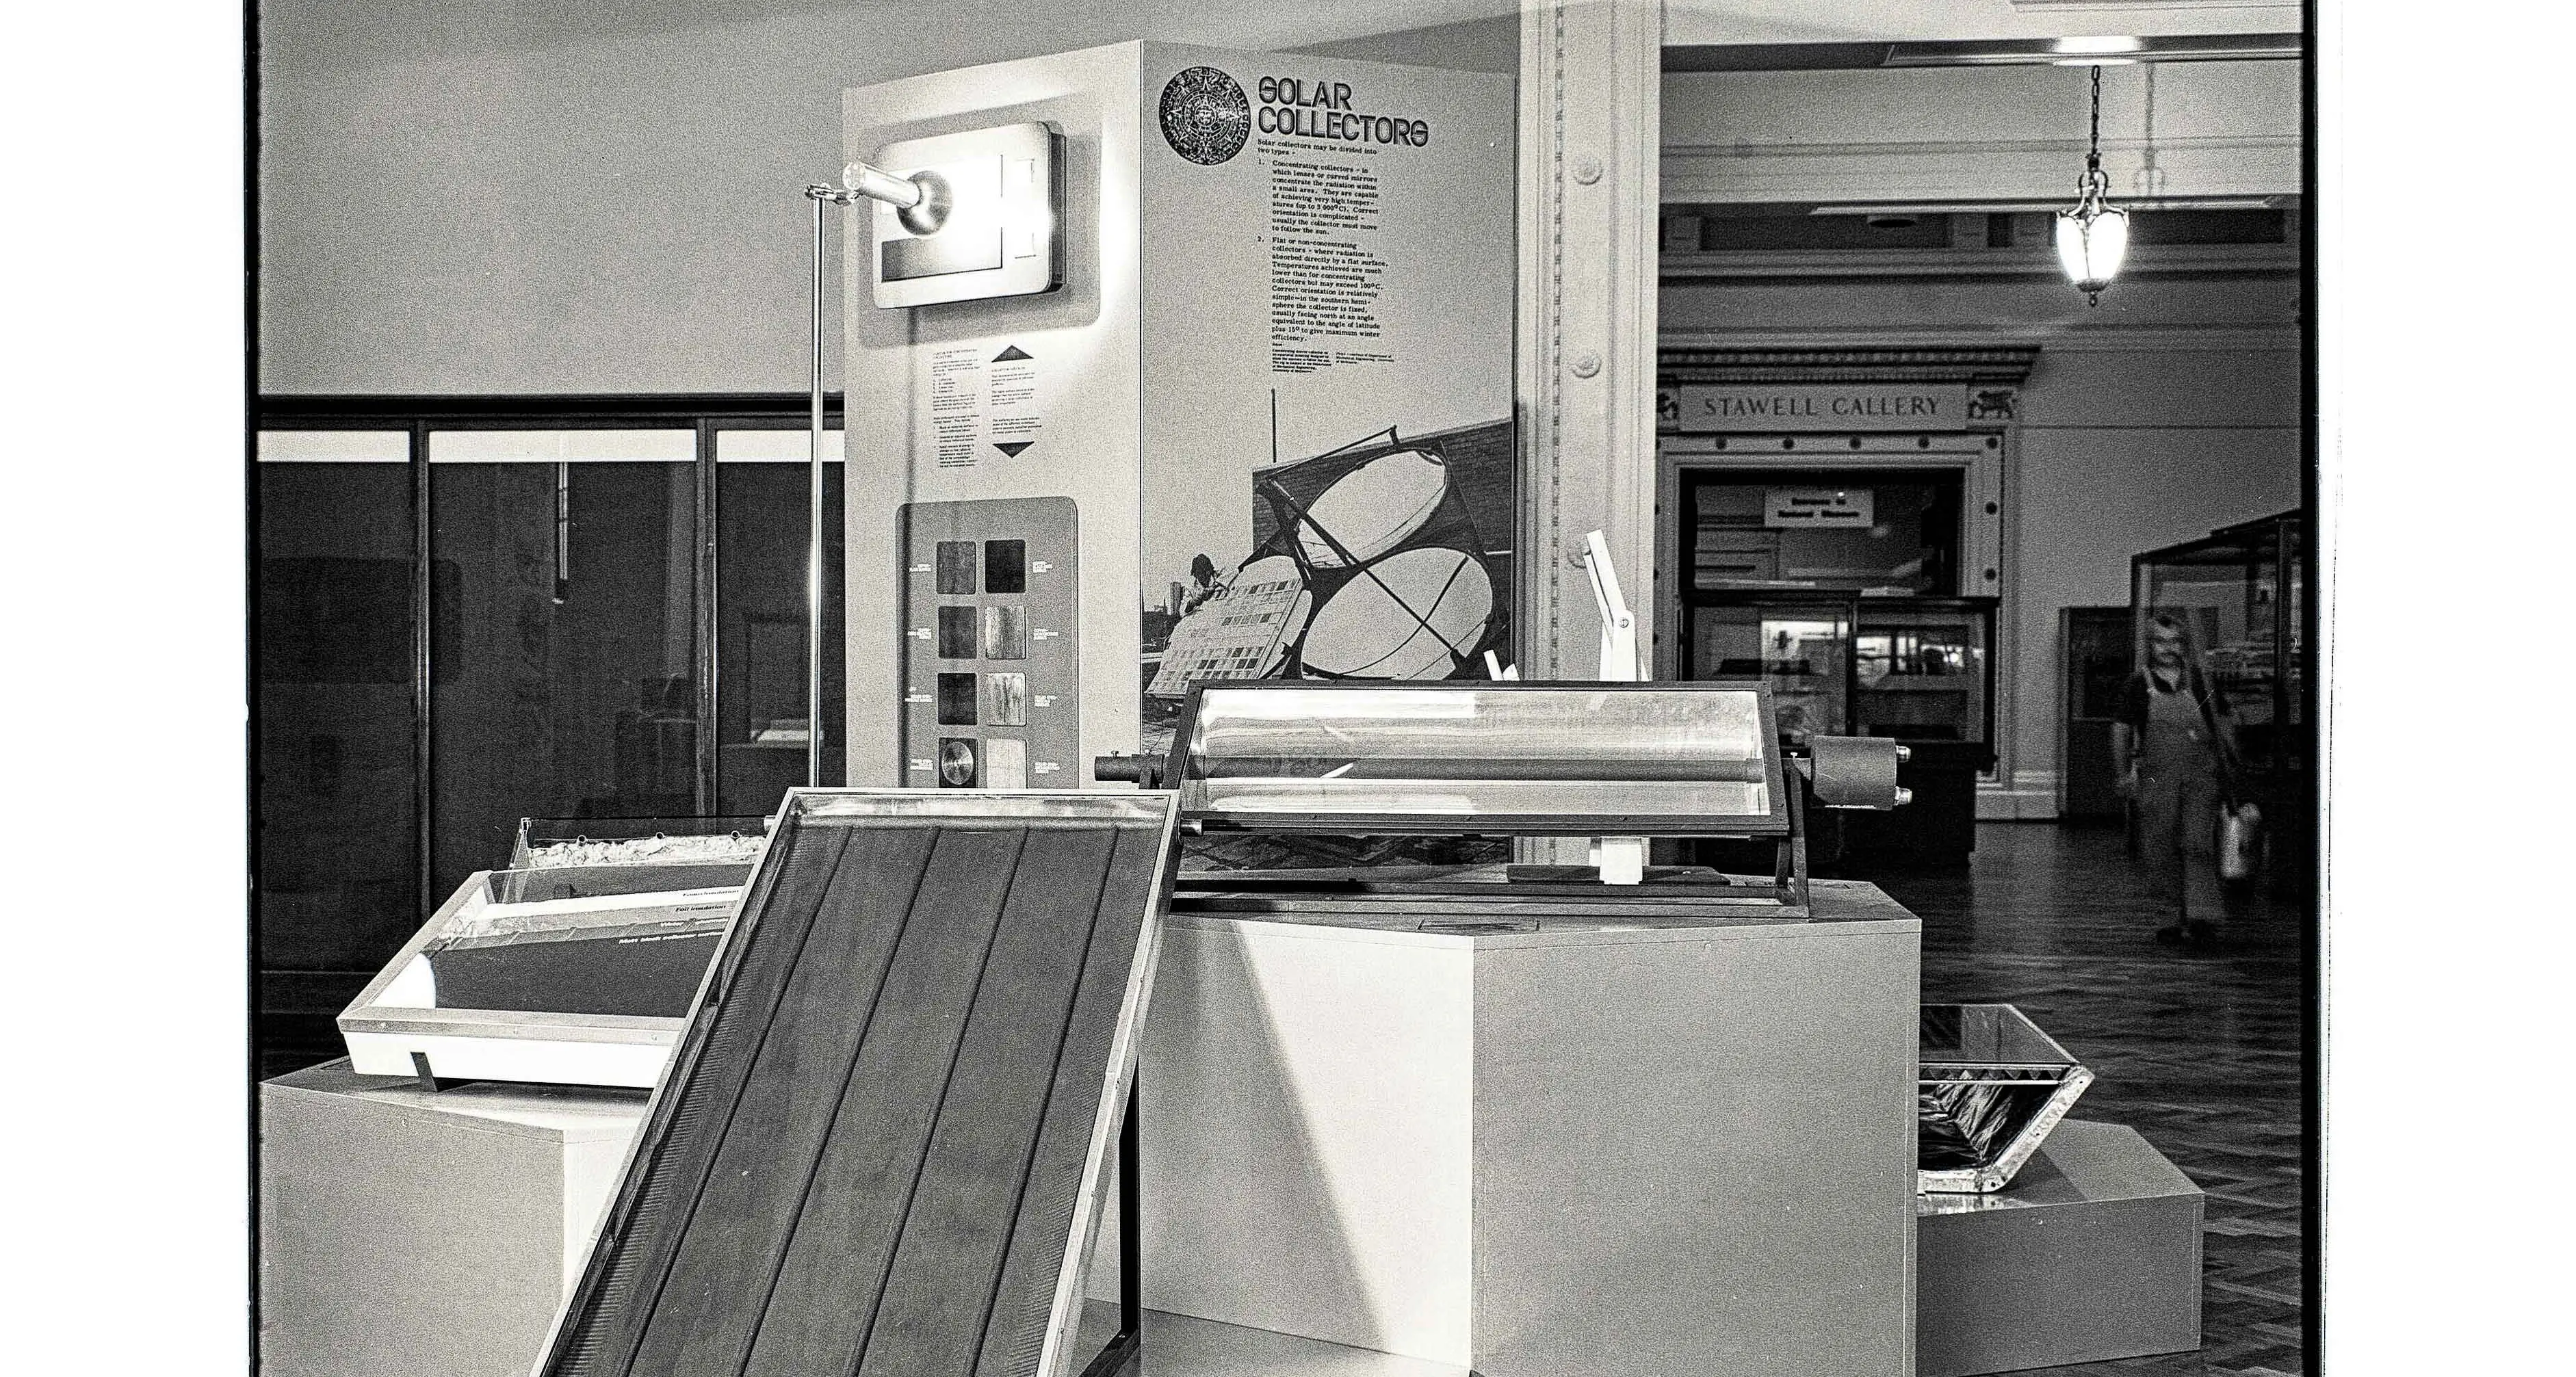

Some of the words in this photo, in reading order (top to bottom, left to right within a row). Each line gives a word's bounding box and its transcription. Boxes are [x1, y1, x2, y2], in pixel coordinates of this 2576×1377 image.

[1259, 76, 1352, 110] SOLAR
[1258, 106, 1429, 147] COLLECTORS
[1258, 138, 1275, 146] Solar
[1277, 140, 1311, 149] collectors
[1339, 145, 1362, 153] divided
[1272, 148, 1289, 156] types
[1273, 159, 1318, 171] Concentrating
[1320, 163, 1353, 172] collectors
[1294, 169, 1314, 177] lenses
[1351, 174, 1377, 182] mirrors
[1325, 180, 1355, 188] radiation
[1282, 193, 1312, 203] achieving
[1314, 196, 1329, 205] very
[1331, 196, 1345, 205] high
[1323, 187, 1339, 197] They
[1354, 191, 1379, 199] capable
[1297, 202, 1306, 211] (up
[1353, 205, 1378, 213] Correct
[1273, 208, 1308, 217] orientation
[1319, 212, 1358, 220] complicated
[1273, 217, 1296, 226] usually
[1310, 219, 1340, 227] collector
[1281, 224, 1301, 233] follow
[1298, 239, 1357, 250] non-concentrating
[1273, 245, 1305, 253] collectors
[1336, 249, 1365, 257] radiation
[1273, 253, 1302, 261] absorbed
[1304, 254, 1330, 265] directly
[1333, 257, 1340, 265] by
[1272, 261, 1319, 270] Temperatures
[1272, 277, 1305, 285] collectors
[1321, 274, 1365, 283] concentrating
[1272, 285, 1298, 293] Correct
[1301, 287, 1336, 295] orientation
[1346, 289, 1378, 299] relatively
[1272, 302, 1294, 310] sphere
[1272, 310, 1295, 319] usually
[1298, 311, 1317, 320] facing
[1357, 314, 1374, 322] angle
[1272, 317, 1305, 326] equivalent
[1328, 320, 1345, 329] angle
[1356, 321, 1380, 329] latitude
[1272, 326, 1286, 334] plus
[1310, 327, 1323, 336] give
[1704, 397, 1817, 416] STAWELL
[1832, 397, 1941, 416] GALLERY
